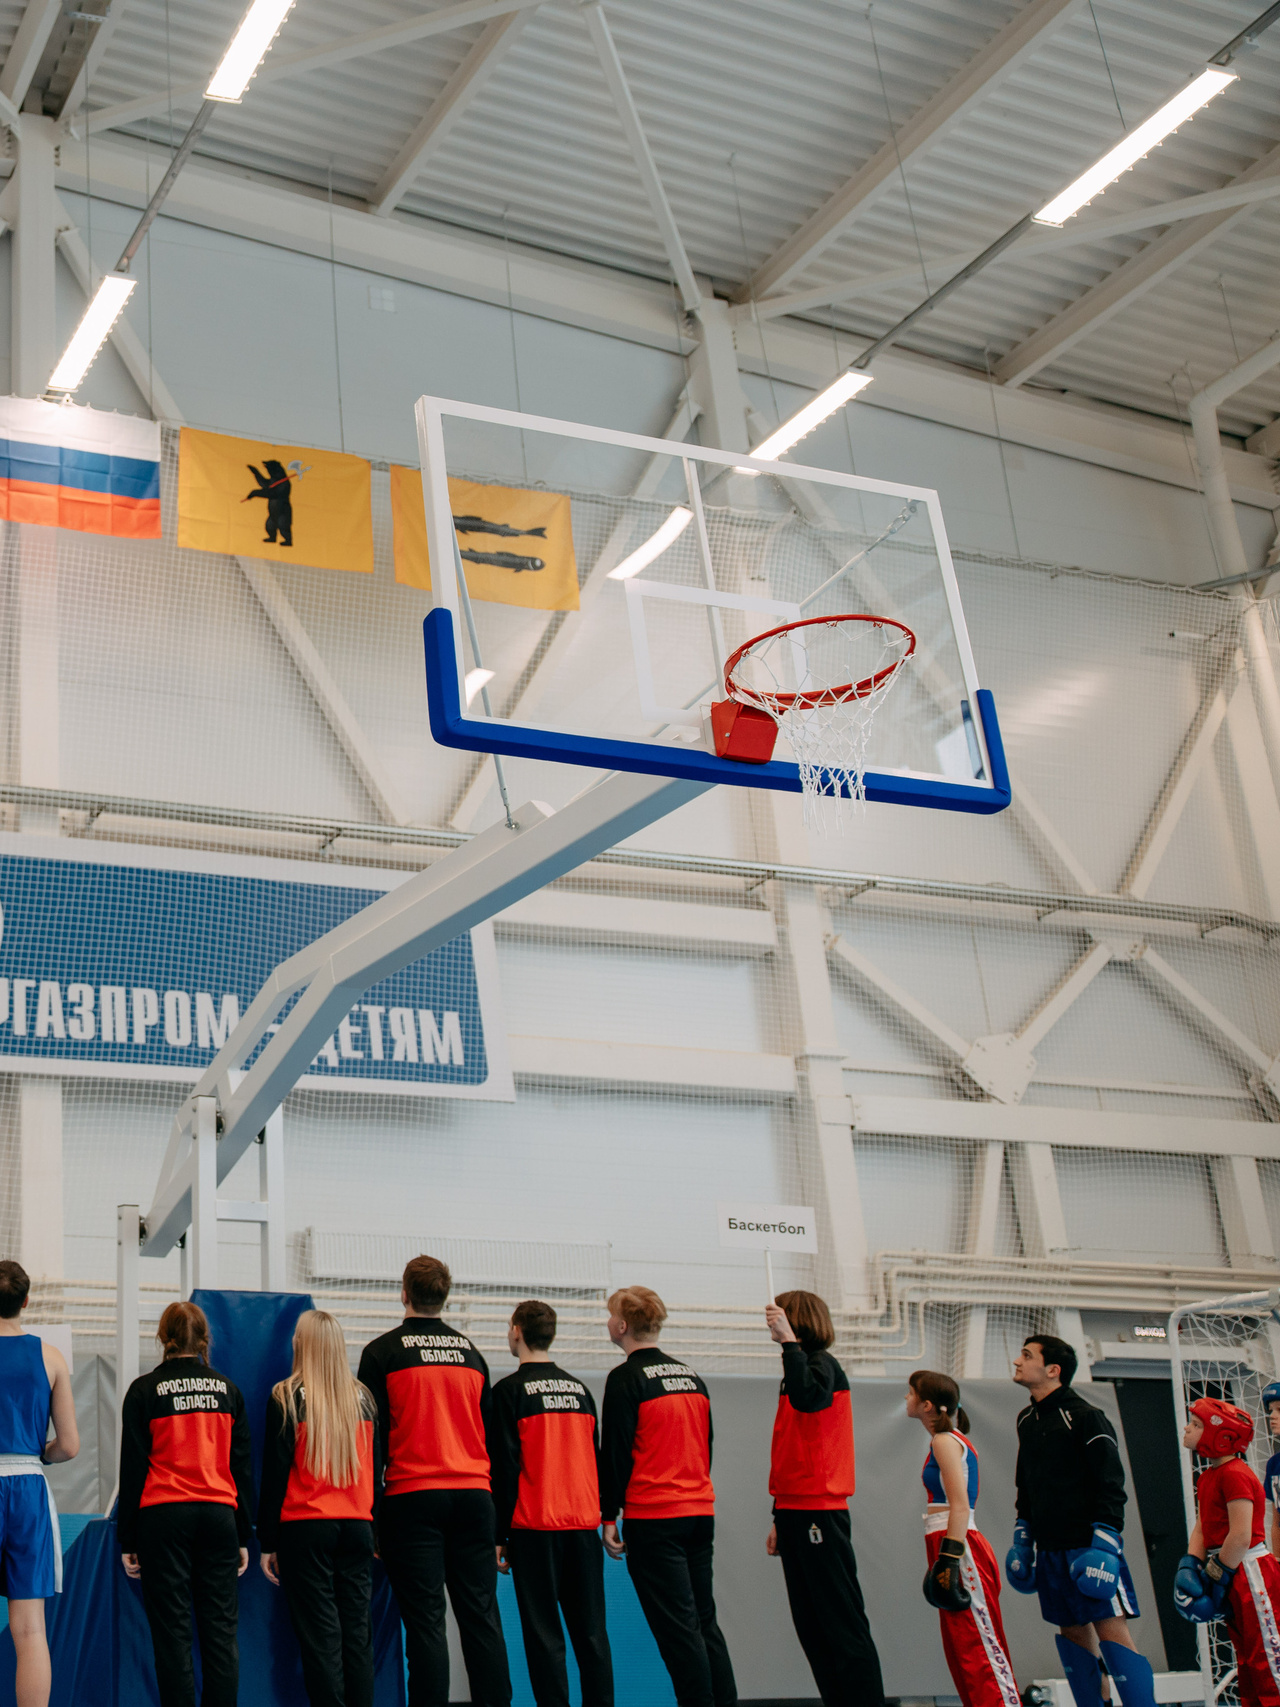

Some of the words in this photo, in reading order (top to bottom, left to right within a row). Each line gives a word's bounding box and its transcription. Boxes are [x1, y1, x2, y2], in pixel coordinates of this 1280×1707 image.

[13, 978, 240, 1050] ГАЗПРОМ
[728, 1217, 806, 1236] Баскетбол
[401, 1335, 472, 1351] ЯРОСЛАВСКАЯ
[420, 1349, 466, 1363] ОБЛАСТЬ
[156, 1378, 227, 1396] ЯРОСЛАВСКАЯ
[524, 1379, 586, 1396] ЯРОСЛАВСКАЯ
[661, 1378, 697, 1391] ОБЛАСТЬ
[173, 1395, 219, 1411] ОБЛАСТЬ
[542, 1395, 580, 1410] ОБЛАСТЬ
